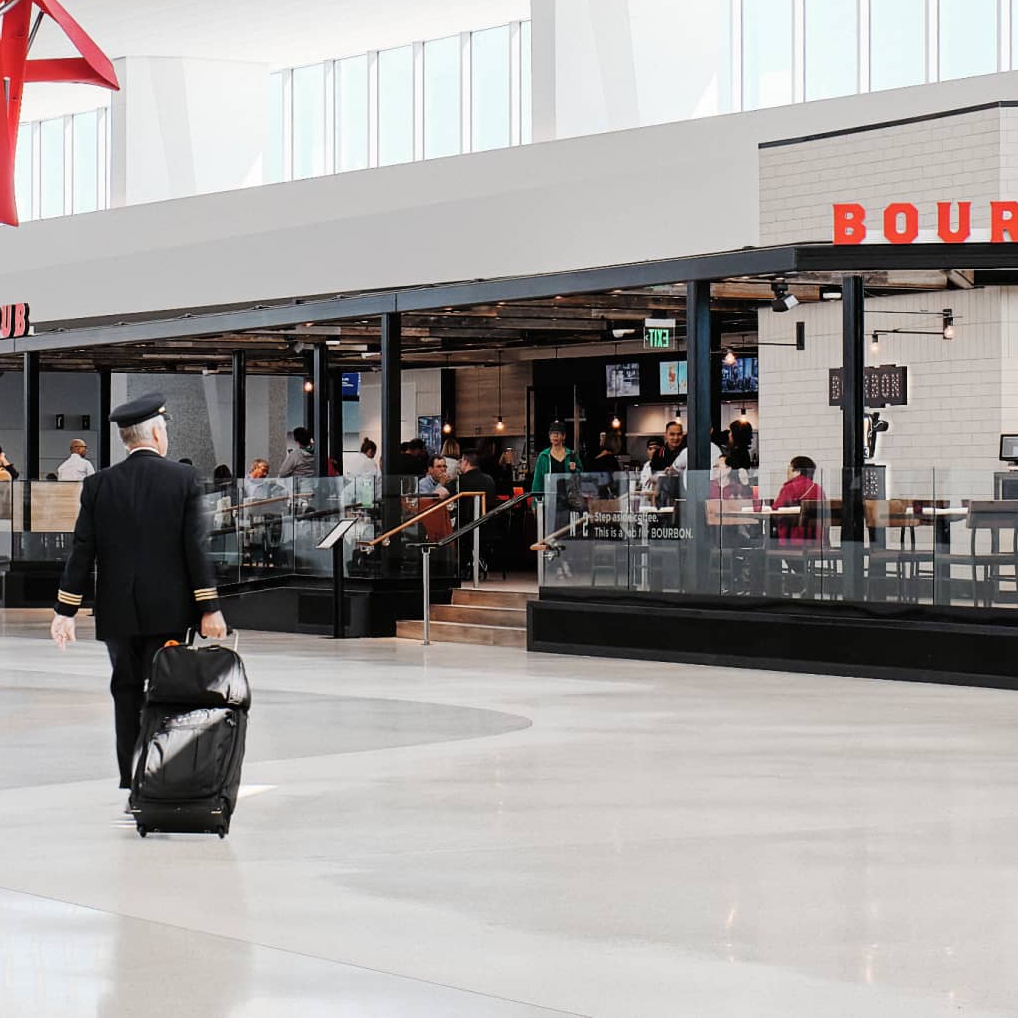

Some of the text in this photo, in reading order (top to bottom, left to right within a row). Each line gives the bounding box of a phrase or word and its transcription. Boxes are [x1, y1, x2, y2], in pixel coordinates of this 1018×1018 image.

[833, 201, 1018, 245] BOUR
[594, 511, 611, 523] Step
[594, 526, 609, 538] This
[610, 526, 617, 538] is
[651, 527, 693, 539] BOURBON.
